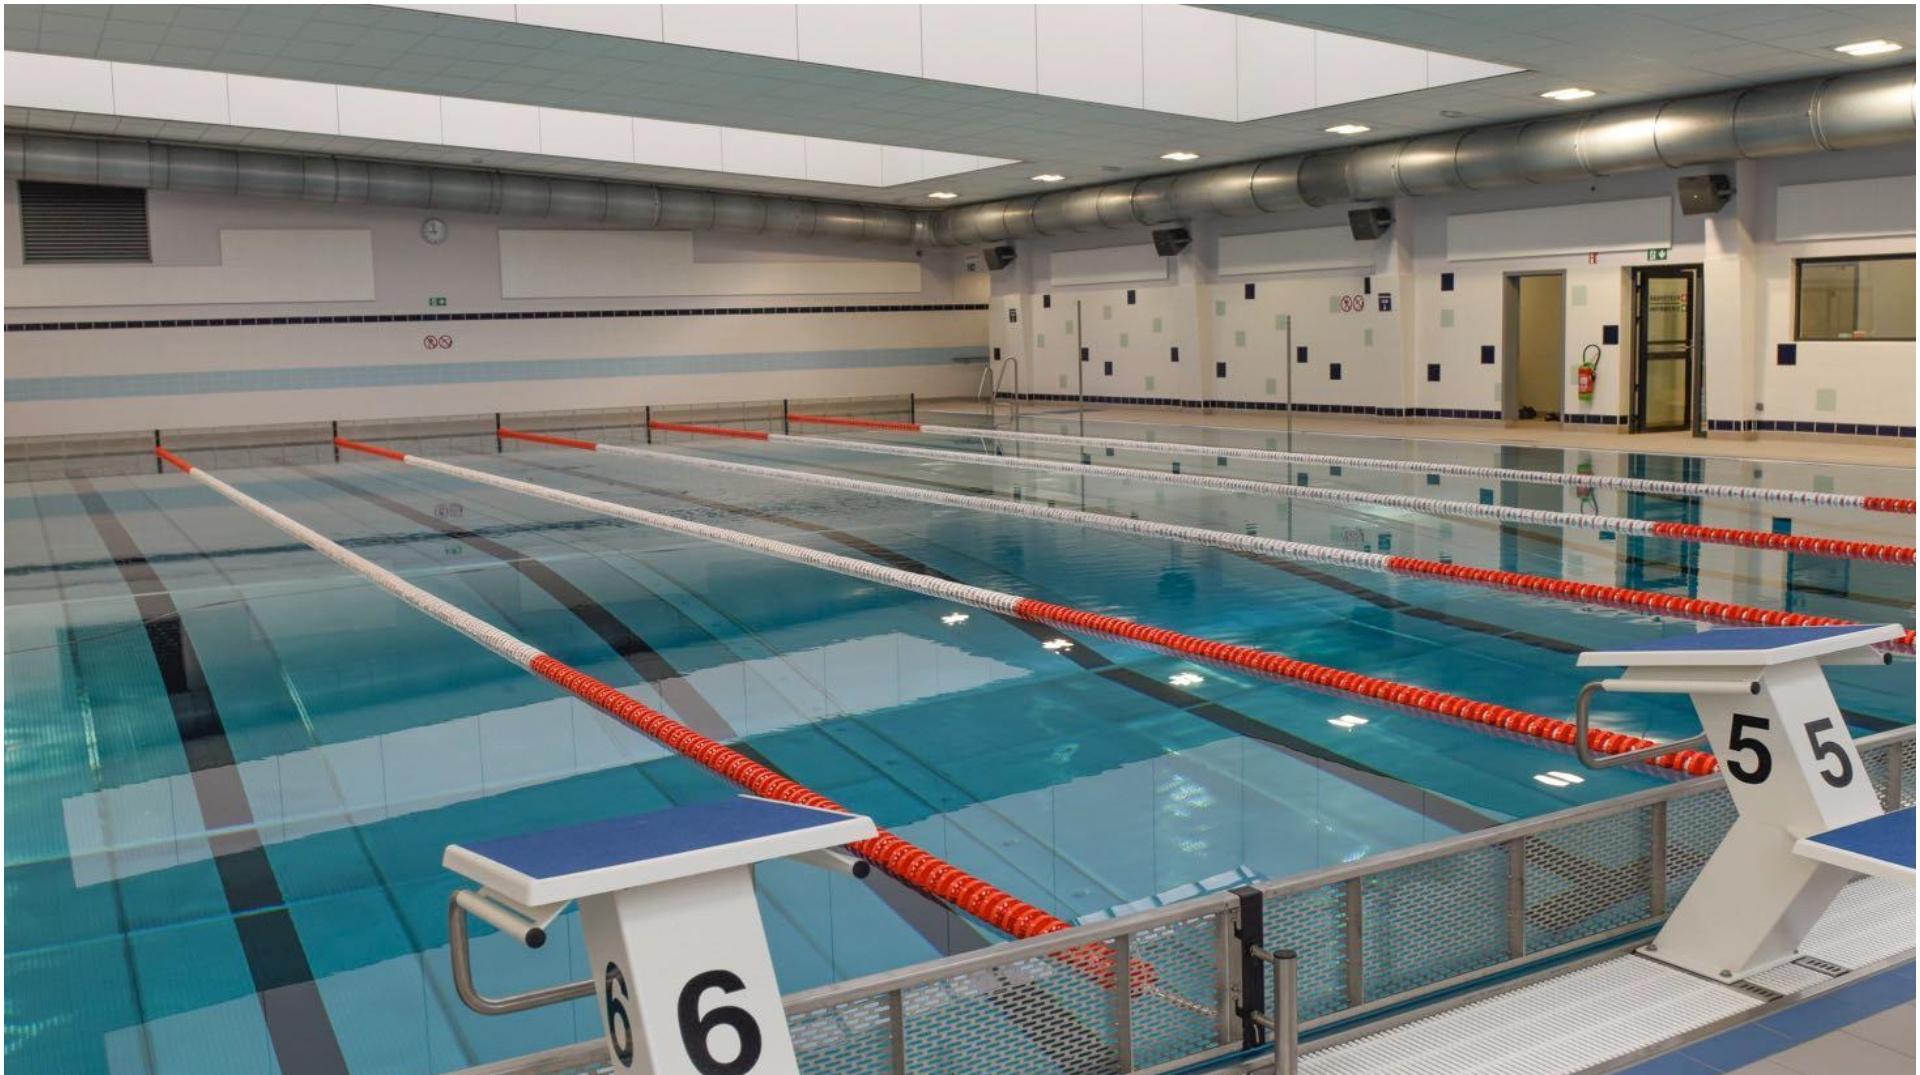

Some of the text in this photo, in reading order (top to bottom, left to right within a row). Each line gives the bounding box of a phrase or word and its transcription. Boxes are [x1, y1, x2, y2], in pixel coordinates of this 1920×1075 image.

[1727, 713, 1772, 785] 5
[1804, 717, 1853, 788] 5
[606, 961, 633, 1068] 6
[678, 969, 762, 1075] 6
